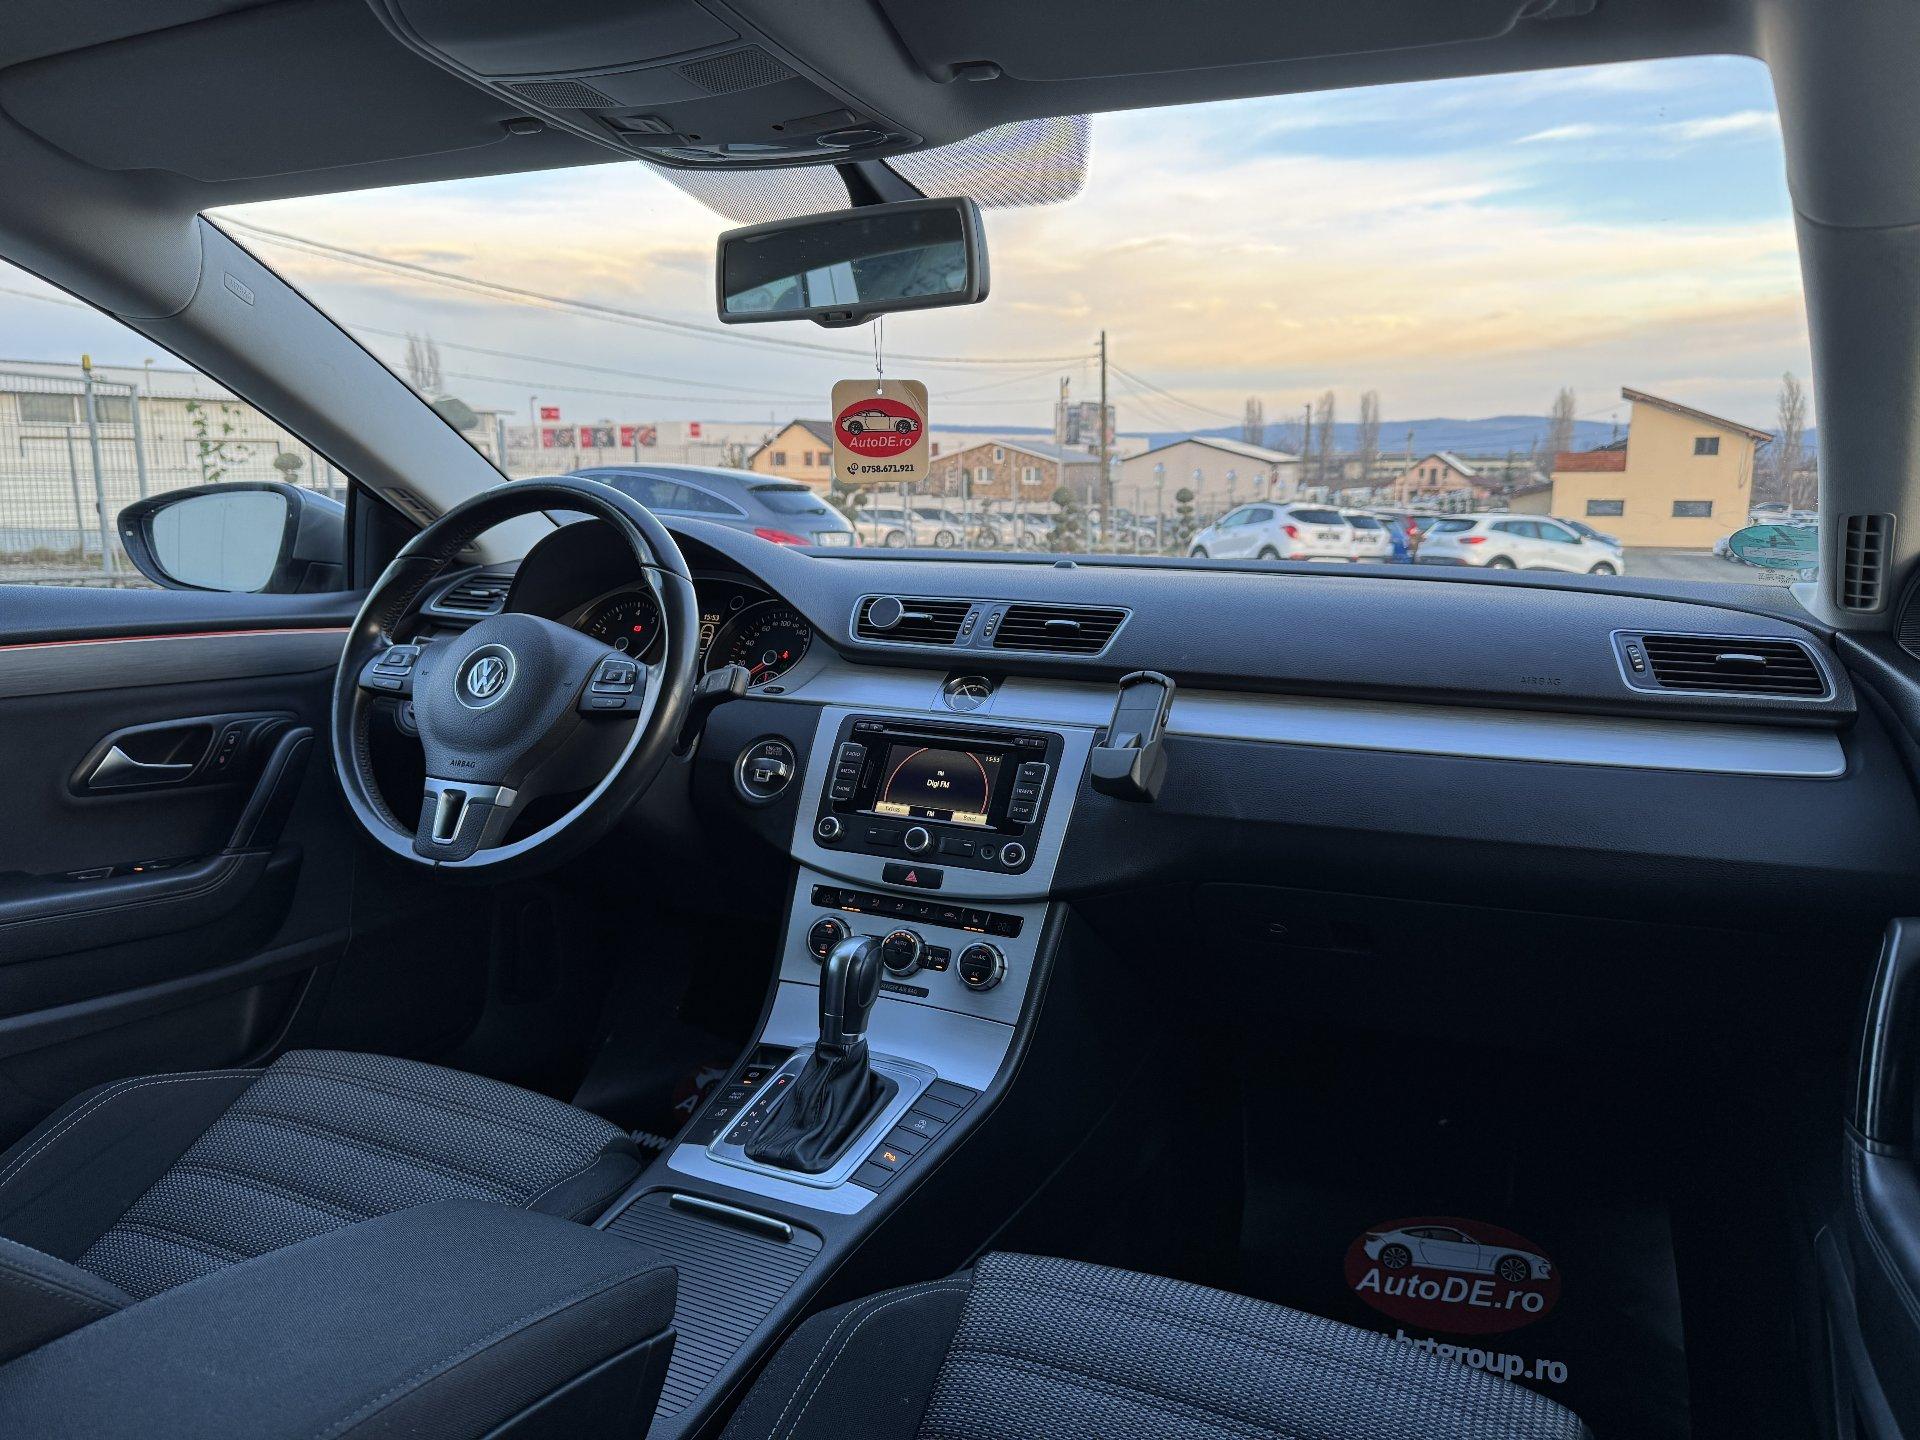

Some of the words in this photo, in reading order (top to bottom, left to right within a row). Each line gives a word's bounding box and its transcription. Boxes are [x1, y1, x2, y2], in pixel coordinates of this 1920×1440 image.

[850, 436, 911, 448] AutoDE.ro
[861, 464, 914, 473] 0758.671.921
[449, 759, 476, 769] AIRBAG
[940, 780, 950, 788] FM
[1355, 1268, 1545, 1313] AutoDE.ro
